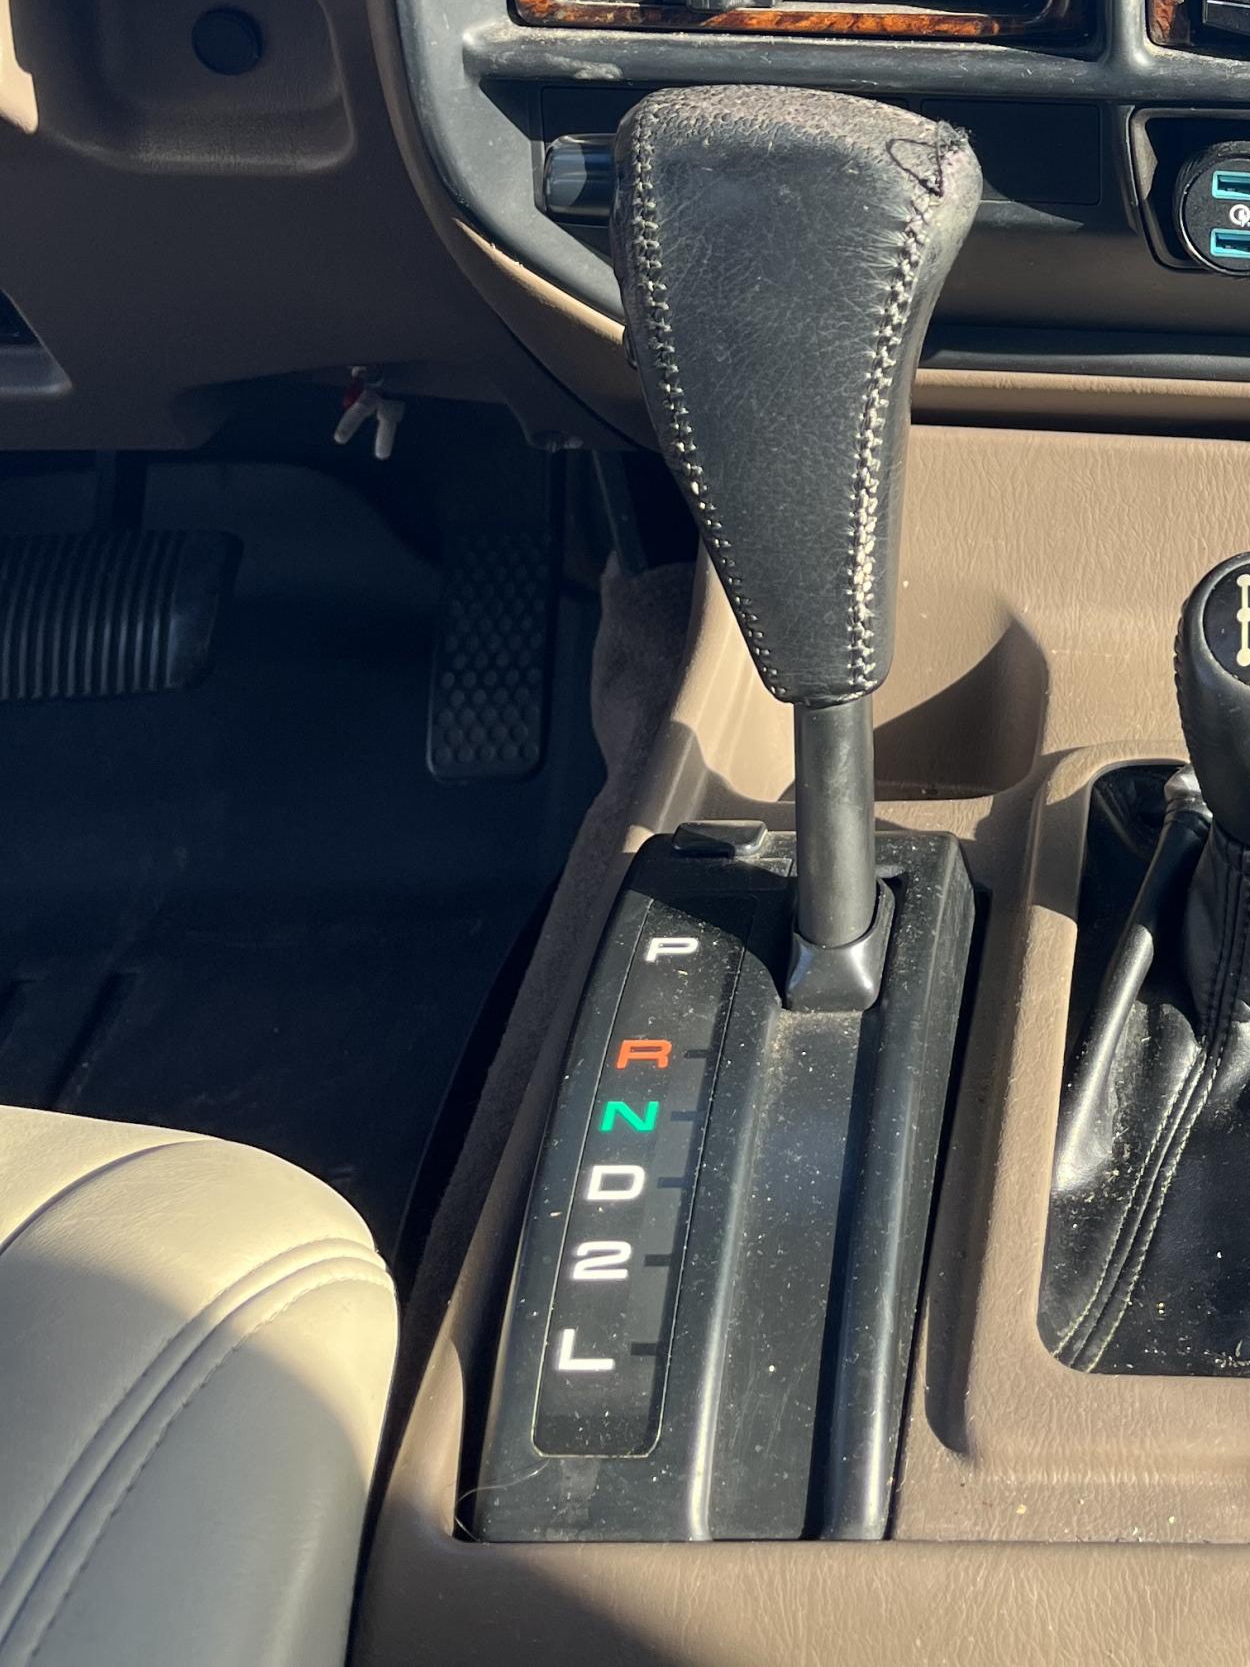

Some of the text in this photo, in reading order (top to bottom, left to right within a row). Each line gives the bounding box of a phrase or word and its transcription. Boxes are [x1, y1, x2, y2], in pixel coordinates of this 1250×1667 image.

[645, 937, 698, 961] P
[615, 1039, 673, 1069] R
[600, 1101, 660, 1133] N
[585, 1165, 647, 1201] D
[571, 1241, 633, 1281] 2
[555, 1328, 616, 1372] L
